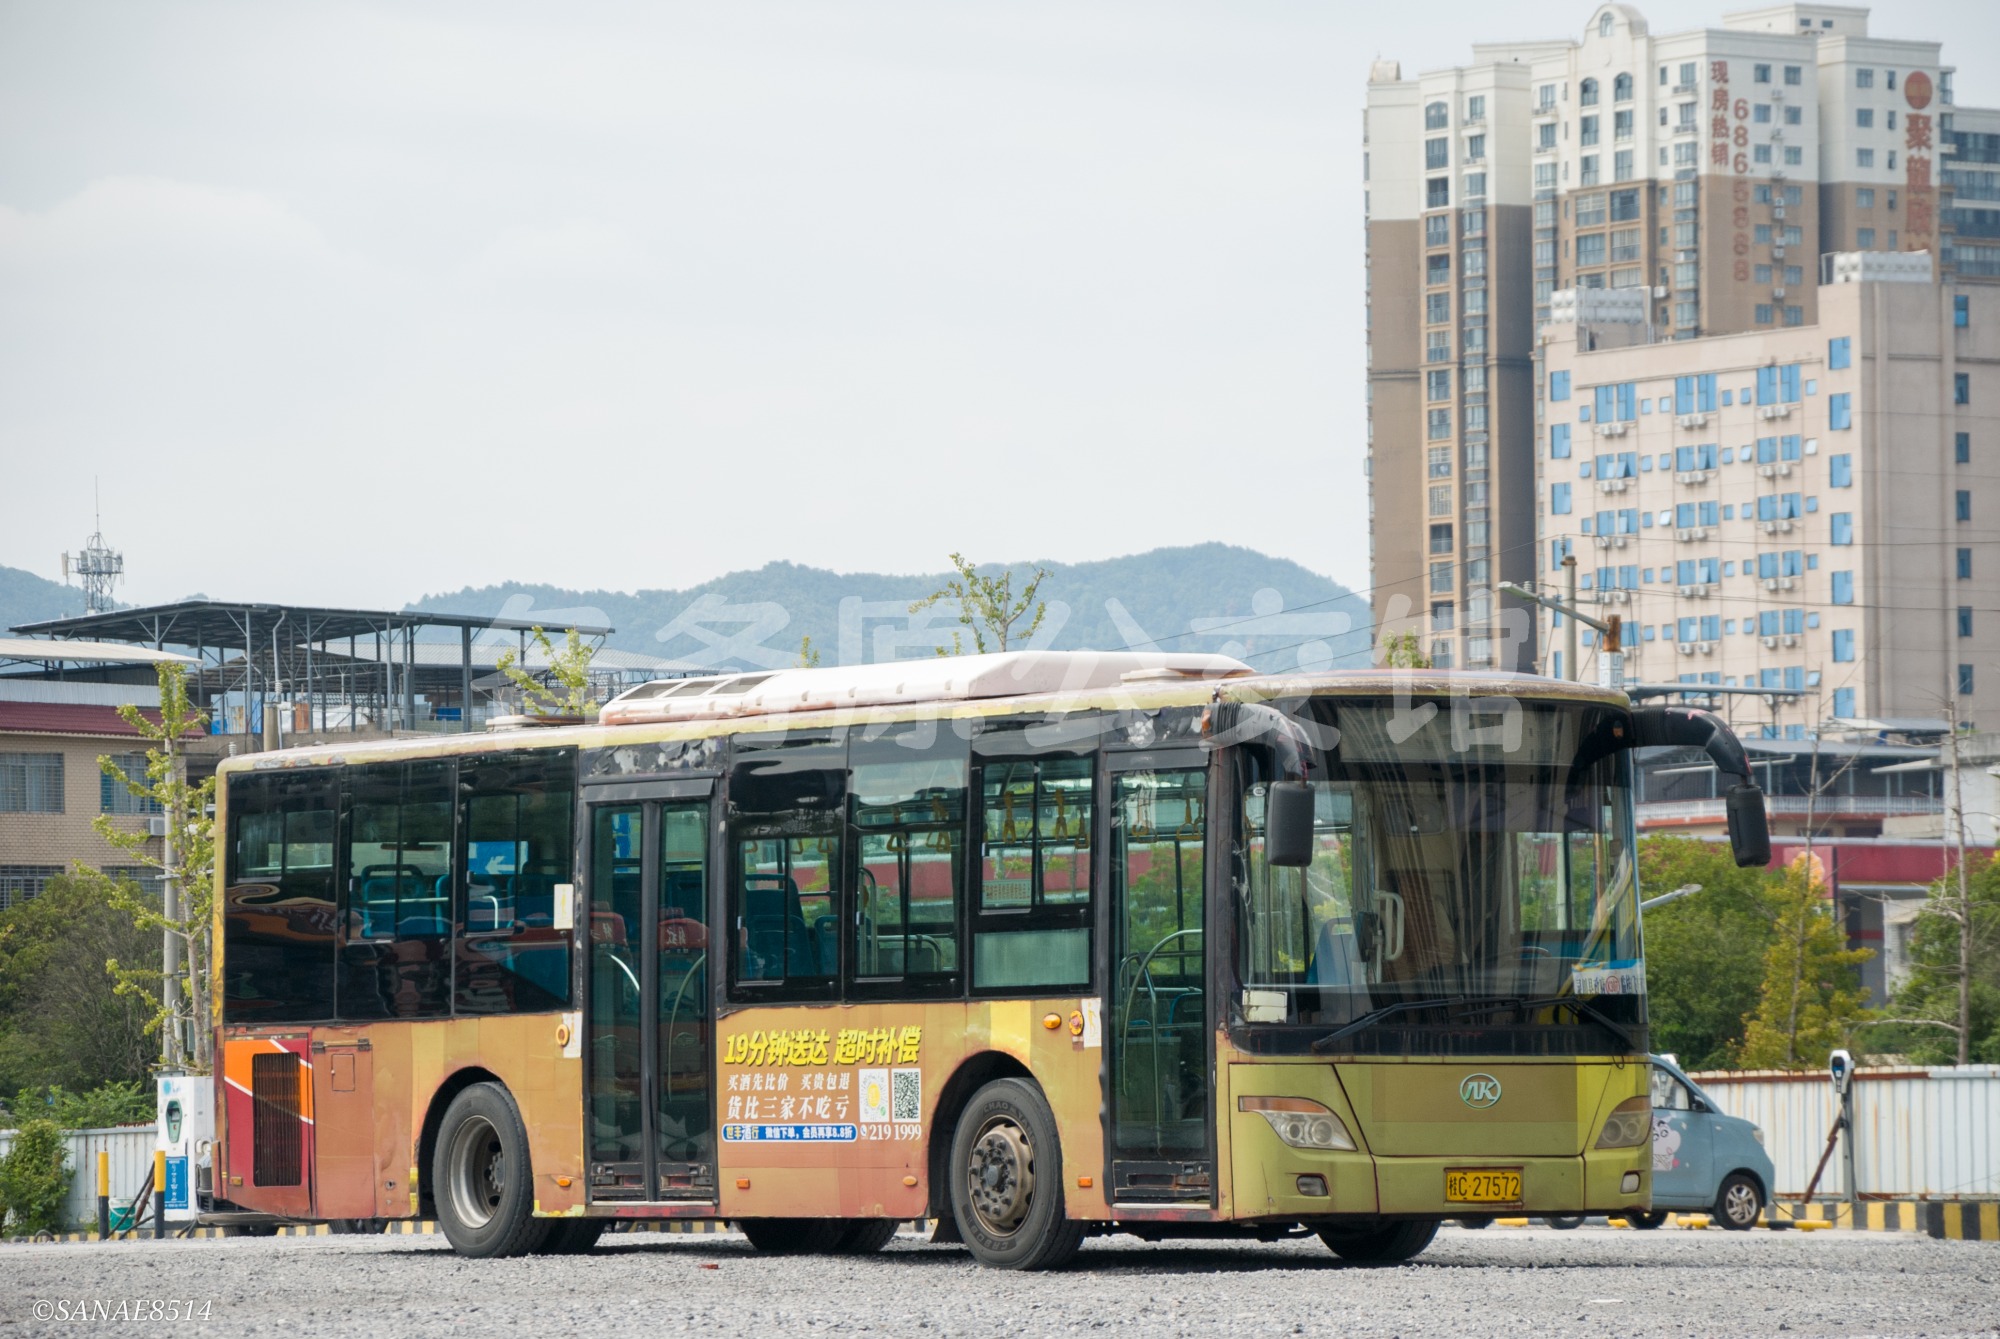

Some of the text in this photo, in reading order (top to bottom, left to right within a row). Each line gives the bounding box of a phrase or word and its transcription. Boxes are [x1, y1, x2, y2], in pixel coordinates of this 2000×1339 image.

[1710, 60, 1730, 166] 现房热销
[723, 1025, 922, 1066] 19分钟送达 超时补偿
[727, 1072, 850, 1091] 买酒先比价 买贵包退
[726, 1095, 850, 1120] 货比三家不吃亏
[869, 1125, 922, 1141] 219 1999
